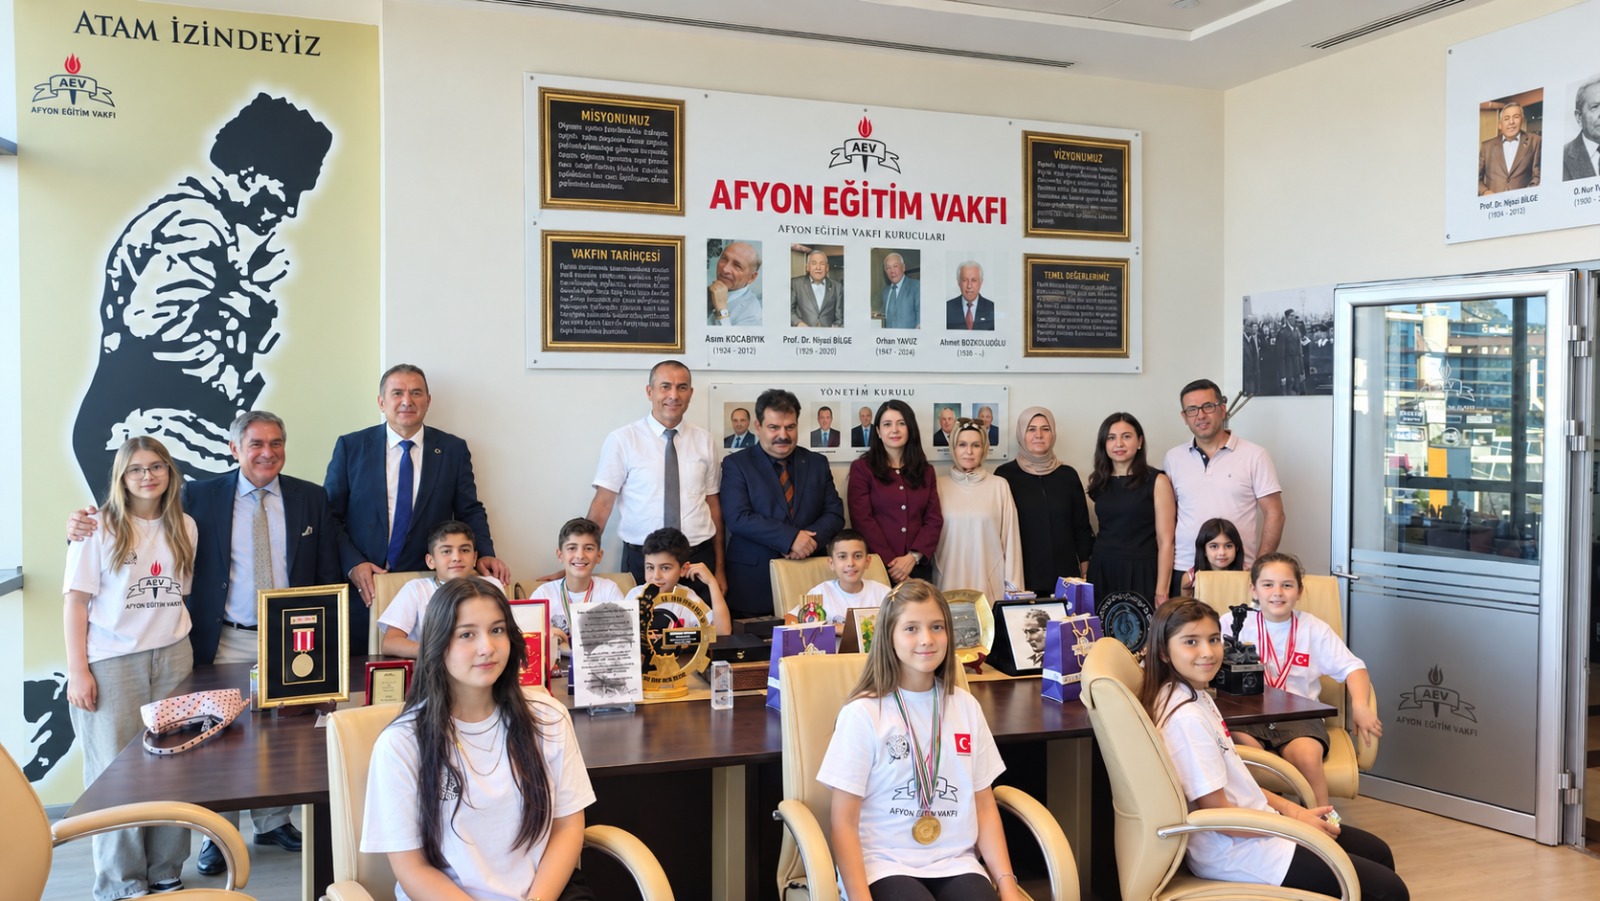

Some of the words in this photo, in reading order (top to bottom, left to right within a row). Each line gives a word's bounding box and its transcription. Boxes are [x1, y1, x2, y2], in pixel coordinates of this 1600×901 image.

[74, 10, 160, 42] ATAM
[171, 16, 322, 57] İZİNDEYİZ
[59, 78, 86, 88] AEV
[31, 106, 59, 115] AFYON
[62, 108, 89, 117] EĞİTİM
[92, 110, 116, 119] VAKFI
[581, 108, 650, 126] MİSYONUMUZ
[852, 142, 877, 154] AEV
[1054, 148, 1103, 163] VİZYONUMUZ
[710, 179, 812, 215] AFYON
[824, 180, 922, 220] EĞİTİM
[930, 193, 1007, 224] VAKFI
[1521, 194, 1538, 204] BİLGE
[778, 224, 812, 234] AFYON
[815, 225, 848, 236] EĞİTİM
[852, 228, 881, 238] VAKFI
[885, 230, 945, 241] KURUCULARI
[572, 248, 608, 260] VAKFIN
[611, 249, 660, 263] TARİHÇESİ
[1044, 271, 1064, 280] TEMEL
[705, 334, 724, 343] Asım
[726, 335, 765, 343] KOCABIYIK
[833, 335, 852, 344] BİLGE
[820, 388, 868, 396] YÖNETİM
[1423, 689, 1449, 700] AEV
[1396, 716, 1421, 727] AFYON
[1453, 726, 1478, 736] VAKFI
[889, 808, 914, 816] AFYON
